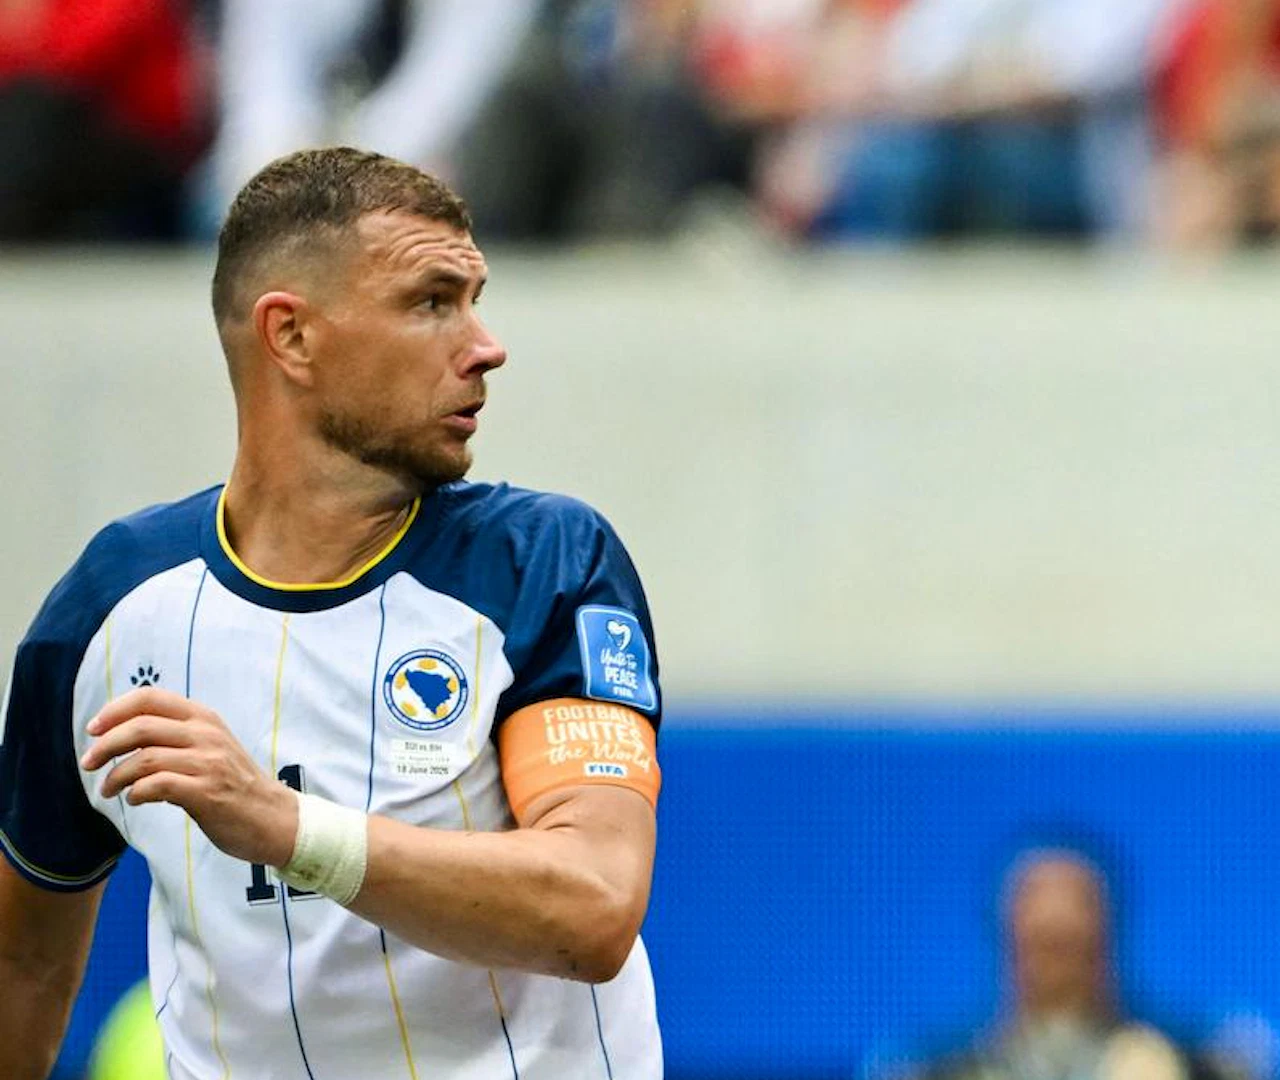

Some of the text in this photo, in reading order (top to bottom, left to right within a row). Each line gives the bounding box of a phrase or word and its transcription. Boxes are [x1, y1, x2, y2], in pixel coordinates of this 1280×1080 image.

[604, 665, 638, 690] PEACE
[546, 721, 645, 757] UNITES
[544, 744, 589, 764] the
[588, 765, 625, 776] FIFA
